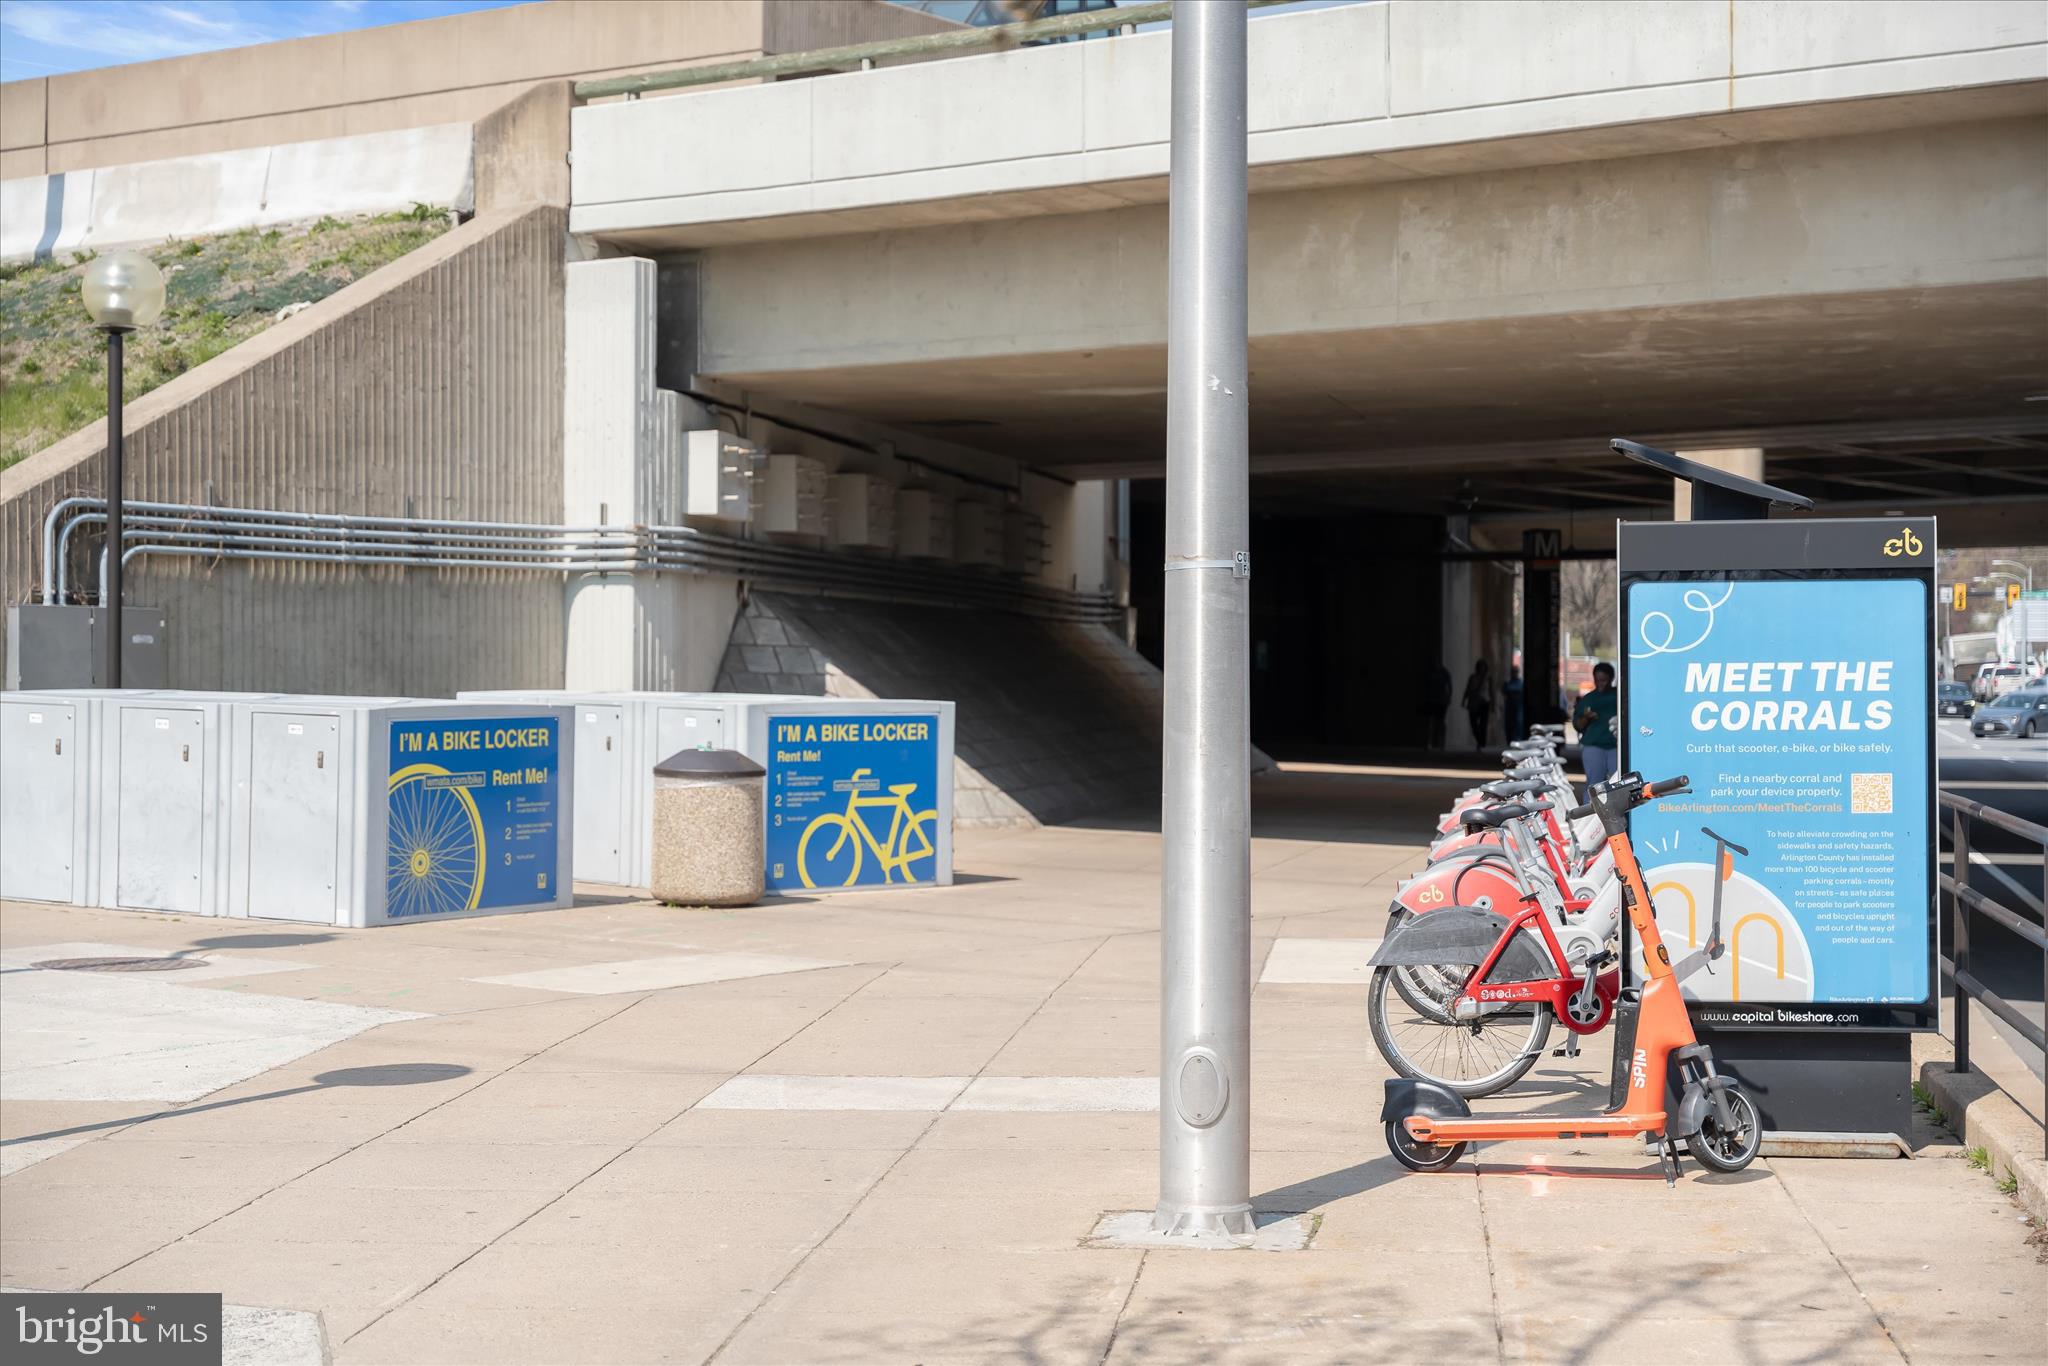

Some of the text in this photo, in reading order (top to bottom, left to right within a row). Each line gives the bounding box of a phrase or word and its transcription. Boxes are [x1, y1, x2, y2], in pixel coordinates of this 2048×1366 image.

[1535, 531, 1559, 557] M
[1684, 661, 1893, 693] MEET THE
[1690, 700, 1893, 731] CORRALS
[778, 723, 928, 742] I'M A BIKE LOCKER
[400, 728, 549, 752] I'M A BIKE LOCKER
[1686, 743, 1893, 755] Curb that scooter, e-bike, or bike safely.
[777, 750, 821, 762] Rent Me!
[492, 768, 548, 786] Rent Me!
[776, 774, 782, 785] 1
[1719, 774, 1741, 783] Find
[1752, 774, 1787, 785] nearby
[1789, 773, 1820, 783] corral
[1822, 773, 1842, 783] and
[1711, 786, 1842, 797] park your device properly.
[506, 800, 511, 812] 1
[774, 795, 782, 807] 2
[1658, 801, 1842, 814] BikeArlington.com/MeetTheCorrals
[774, 814, 782, 826] 3
[505, 827, 512, 840] 2
[1767, 830, 1894, 839] To help alleviate crowding on the
[1777, 842, 1816, 850] sidewalks
[1818, 842, 1832, 850] and
[1834, 842, 1859, 850] safety
[505, 853, 512, 866] 3
[1781, 854, 1894, 862] Arlington County has installed
[1765, 865, 1894, 873] more than 100 bicycle and scooter
[1868, 877, 1894, 885] mostly
[1840, 889, 1849, 897] as
[1850, 889, 1867, 897] safe
[1869, 889, 1894, 897] places
[1795, 901, 1894, 909] for people to park scooters
[1816, 924, 1895, 932] and out of the way of
[1633, 1048, 1647, 1088] SPIN
